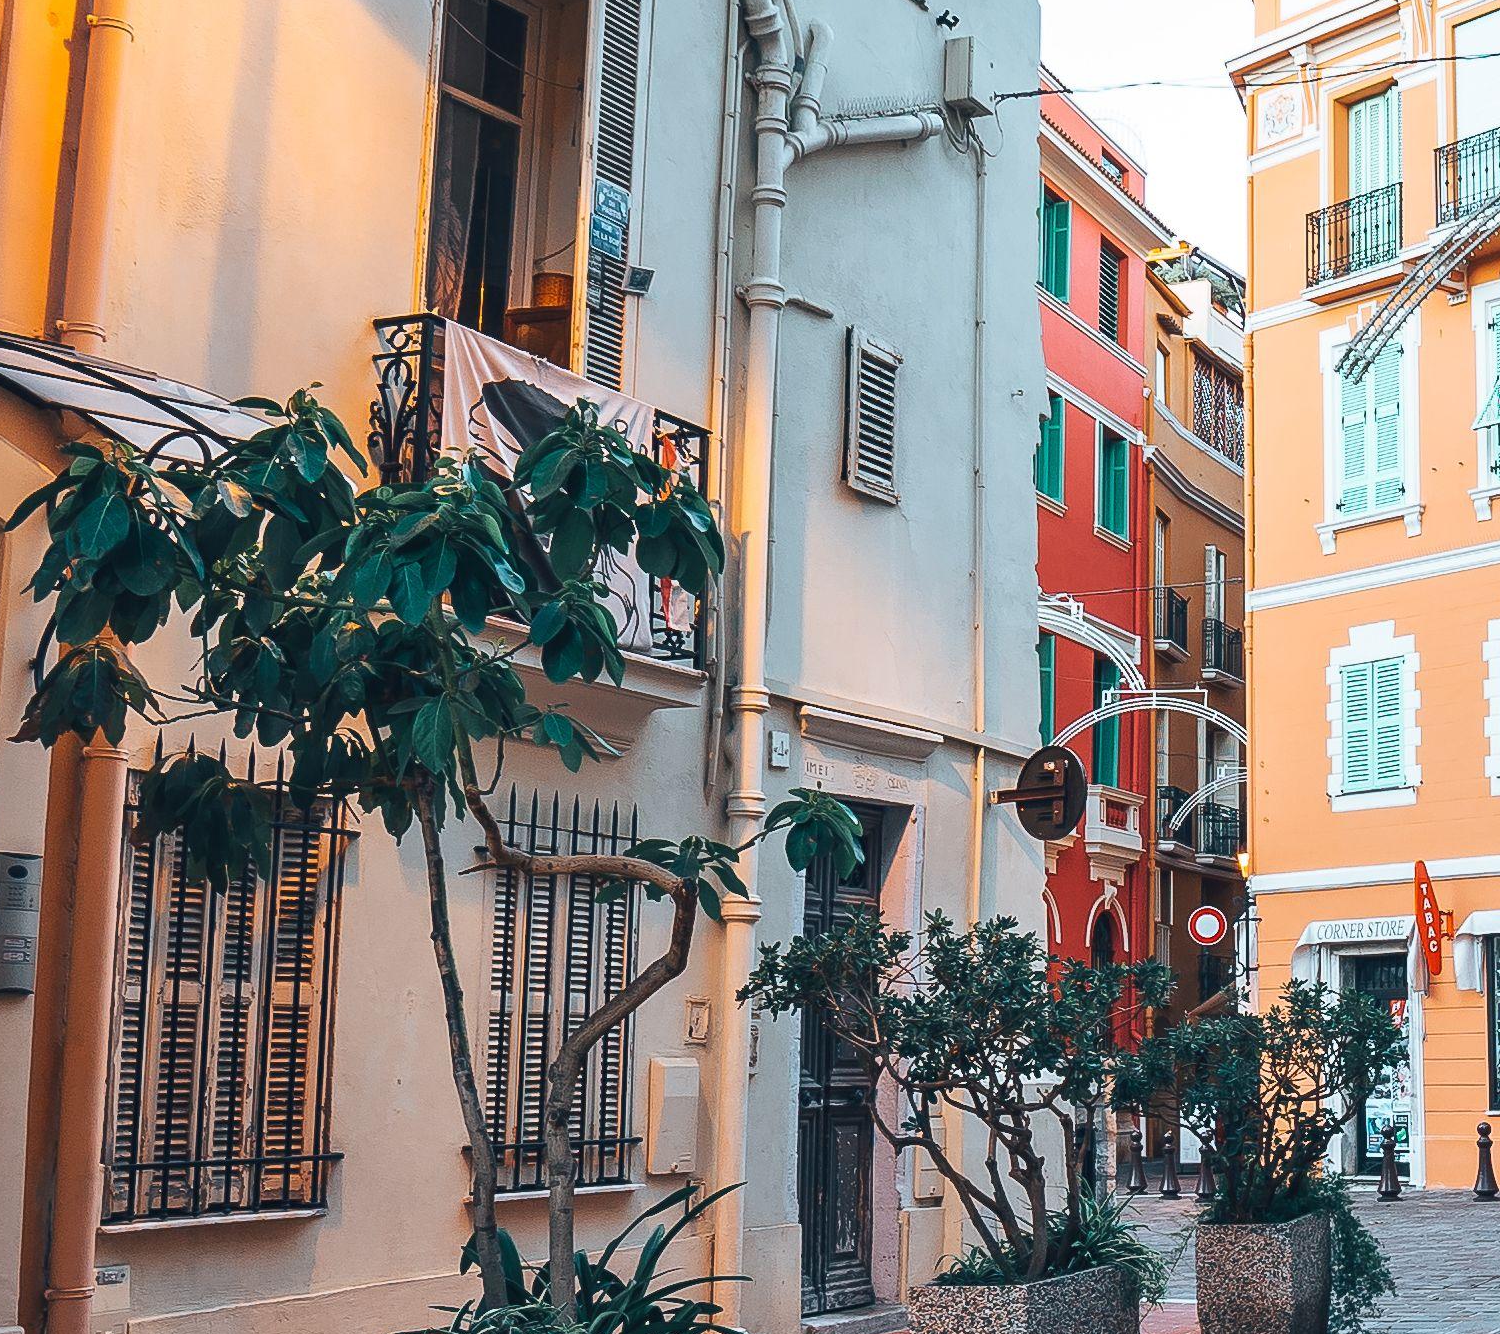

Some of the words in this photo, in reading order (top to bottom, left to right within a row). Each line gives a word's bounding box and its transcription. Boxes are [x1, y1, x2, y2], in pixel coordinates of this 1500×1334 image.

[1317, 922, 1364, 940] CORNER
[1366, 919, 1405, 938] STORE
[1420, 883, 1438, 953] TABAC
